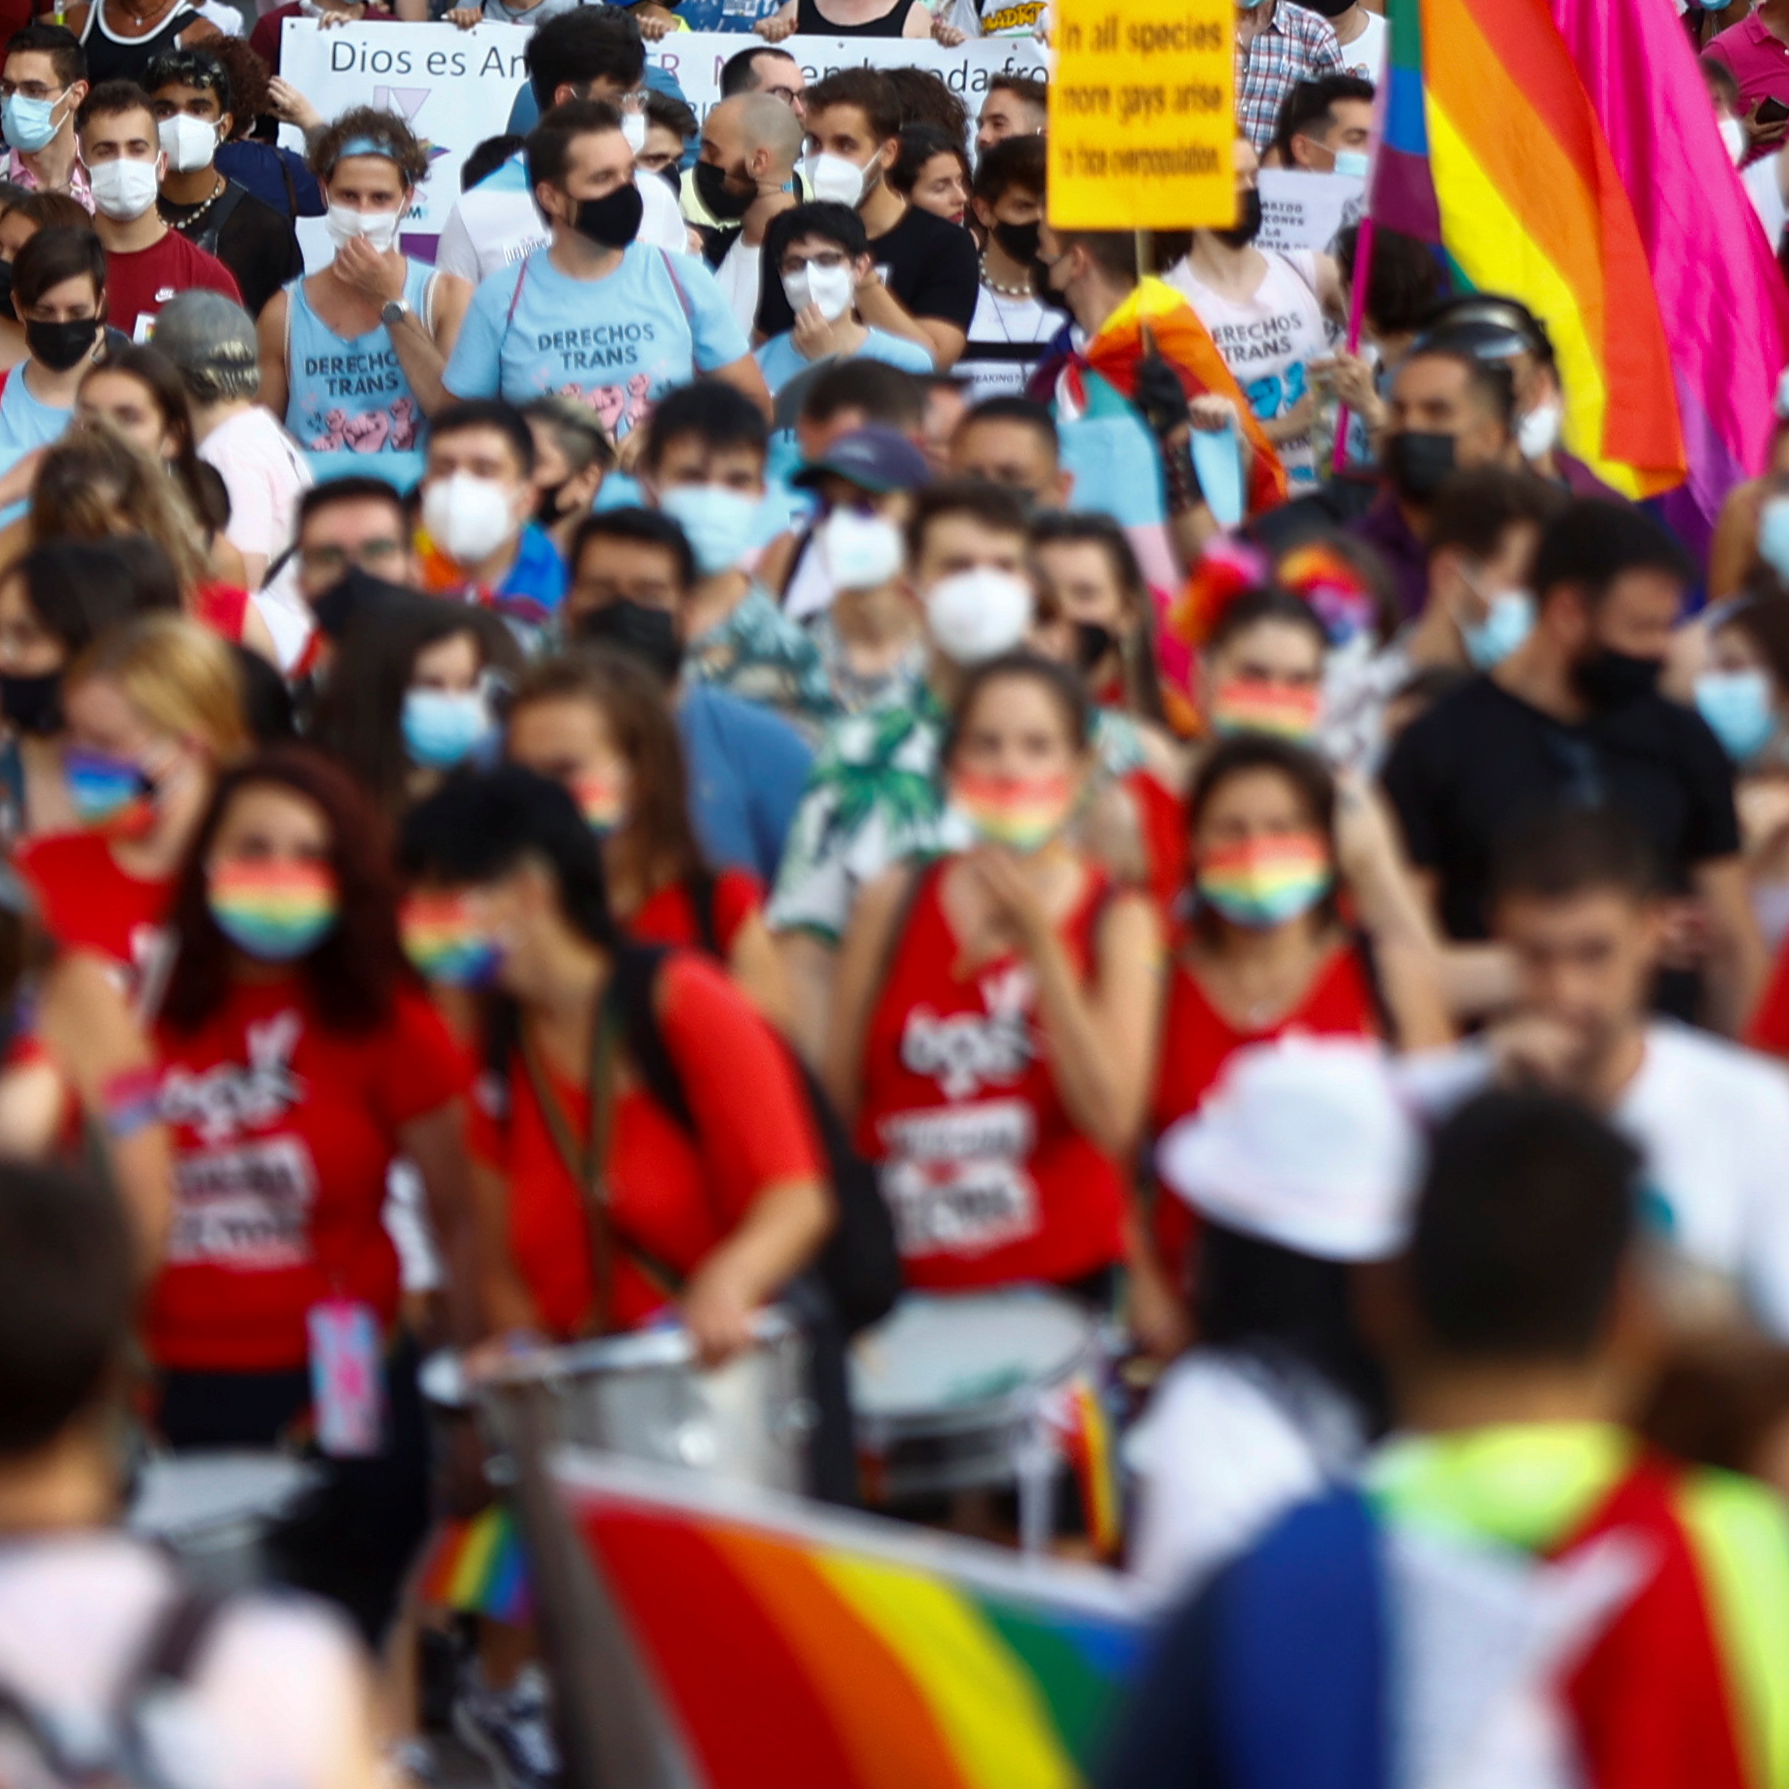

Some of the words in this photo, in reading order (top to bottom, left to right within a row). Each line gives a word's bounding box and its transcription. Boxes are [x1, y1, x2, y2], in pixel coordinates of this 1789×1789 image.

[1090, 12, 1119, 52] all
[1126, 15, 1223, 59] species
[331, 40, 412, 75] Dios
[426, 50, 466, 77] es
[1061, 84, 1110, 113] more
[1119, 83, 1166, 126] gays
[1174, 77, 1223, 114] arise
[537, 322, 655, 352] DERECHOS
[1212, 312, 1302, 345] ERECHOS
[305, 351, 399, 377] DERECHO
[559, 345, 639, 372] TRANS
[1221, 336, 1293, 363] TRANS
[324, 371, 399, 398] TRANS
